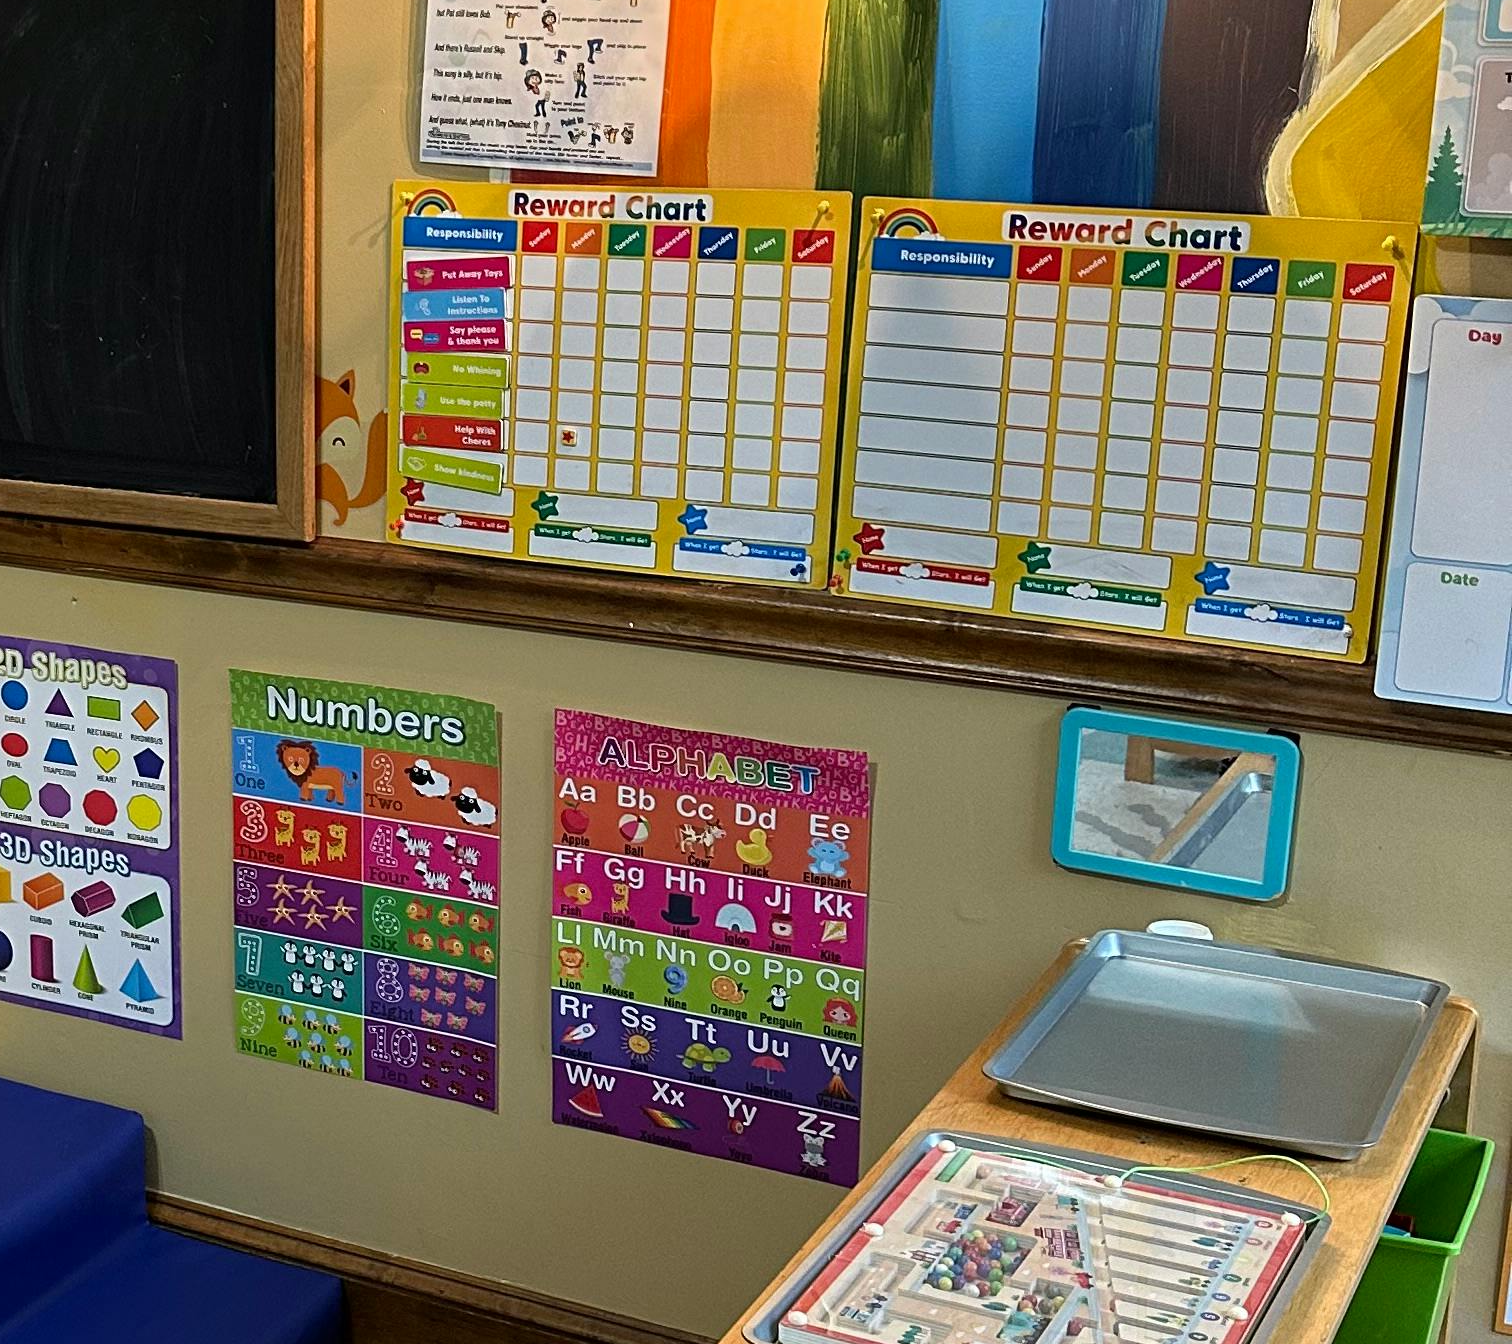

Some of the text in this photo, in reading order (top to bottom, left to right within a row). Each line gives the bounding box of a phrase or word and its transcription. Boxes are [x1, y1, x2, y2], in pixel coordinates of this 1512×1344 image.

[514, 192, 706, 221] Reward Chart
[427, 227, 829, 259] Responsibility Sunday Monday Tuesday Wednesday Thursday Friday Saturday
[1009, 214, 1242, 251] Reward Chart
[442, 269, 503, 279] Put Away Toys
[901, 249, 1387, 296] Responsibility Sunday Monday Tuesday Wednesday Thursday Friday Saturday
[447, 307, 498, 315] Instructions
[452, 295, 490, 304] Listen To
[448, 336, 499, 346] & thank you
[450, 326, 496, 335] Say please
[1468, 329, 1502, 345] Day
[453, 365, 501, 377] No Whining
[440, 397, 496, 409] Use the potty
[455, 426, 496, 436] Help With
[462, 437, 491, 446] Chores
[434, 464, 494, 481] Show kindness
[1441, 571, 1479, 586] Date
[32, 650, 128, 690] Shapes
[265, 685, 466, 745] Numbers
[235, 734, 395, 796] 1 2
[598, 736, 821, 795] ALPHABET
[235, 772, 403, 812] One Two
[559, 778, 850, 841] Aa Bb Cc Dd Ee
[0, 832, 131, 876] 3D Shapes
[240, 800, 398, 868] 3 4
[236, 843, 408, 887] Three Four
[561, 834, 852, 890] Apple Ball Cow Duck Elephant
[236, 867, 401, 937] 5 6
[556, 852, 852, 919] Ff Gg Hh Ii Jj Kk
[370, 934, 397, 952] Six
[561, 904, 841, 963] Fish Giraffe Jam Kite
[238, 934, 404, 1002] 7 8
[557, 922, 860, 1001] Ll Mm Nn Oo Pp Qq
[237, 973, 415, 1024] Seven Eight
[560, 977, 857, 1042] Lion Mouse Nine Orange Penguin Queen
[241, 998, 418, 1068] 9 10
[560, 994, 858, 1072] Rr Ss Tt Uu Vv
[240, 1037, 408, 1085] Nine Ten
[565, 1063, 836, 1139] Ww Xx Yy Zz
[816, 1094, 859, 1115] Volcano
